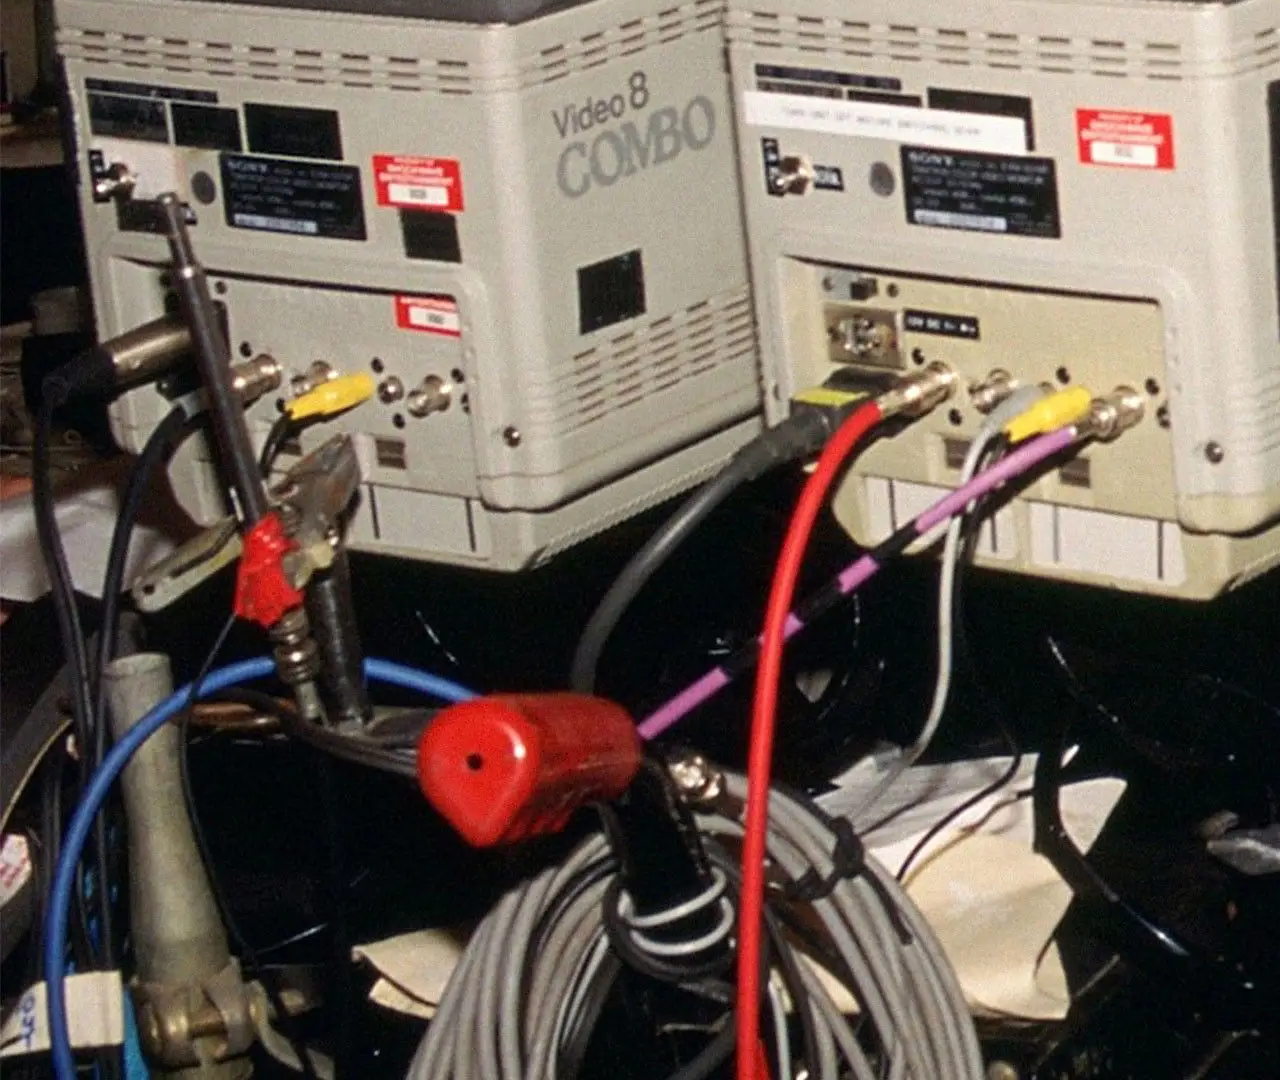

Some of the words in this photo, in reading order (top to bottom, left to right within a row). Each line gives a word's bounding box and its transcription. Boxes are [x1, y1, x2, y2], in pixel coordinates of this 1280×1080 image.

[551, 94, 626, 139] Video
[628, 70, 649, 110] 8
[556, 95, 716, 199] COMBO
[908, 151, 954, 168] SONY
